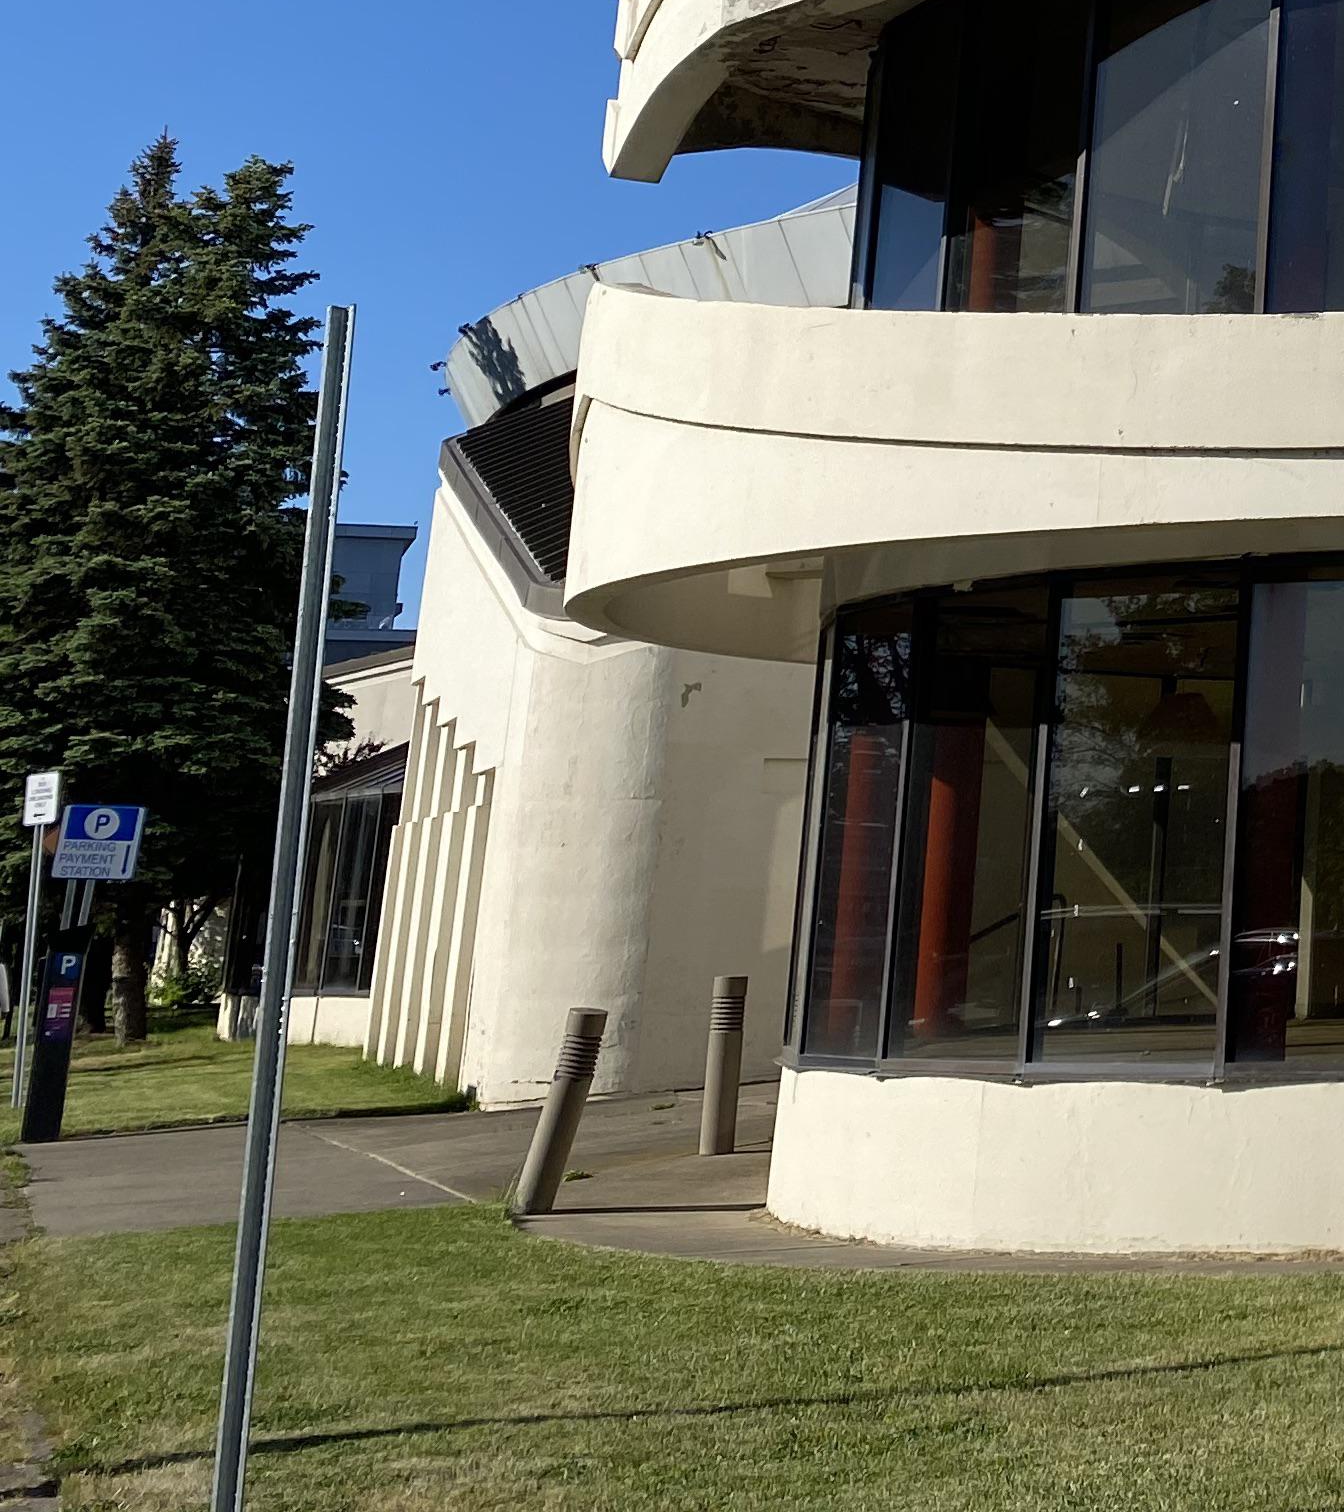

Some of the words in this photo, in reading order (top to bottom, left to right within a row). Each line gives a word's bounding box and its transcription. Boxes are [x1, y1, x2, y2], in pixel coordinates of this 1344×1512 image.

[94, 814, 111, 834] P
[63, 841, 117, 852] PARKING
[59, 853, 117, 865] PAYMENT
[60, 865, 112, 877] STATION
[60, 955, 77, 975] P
